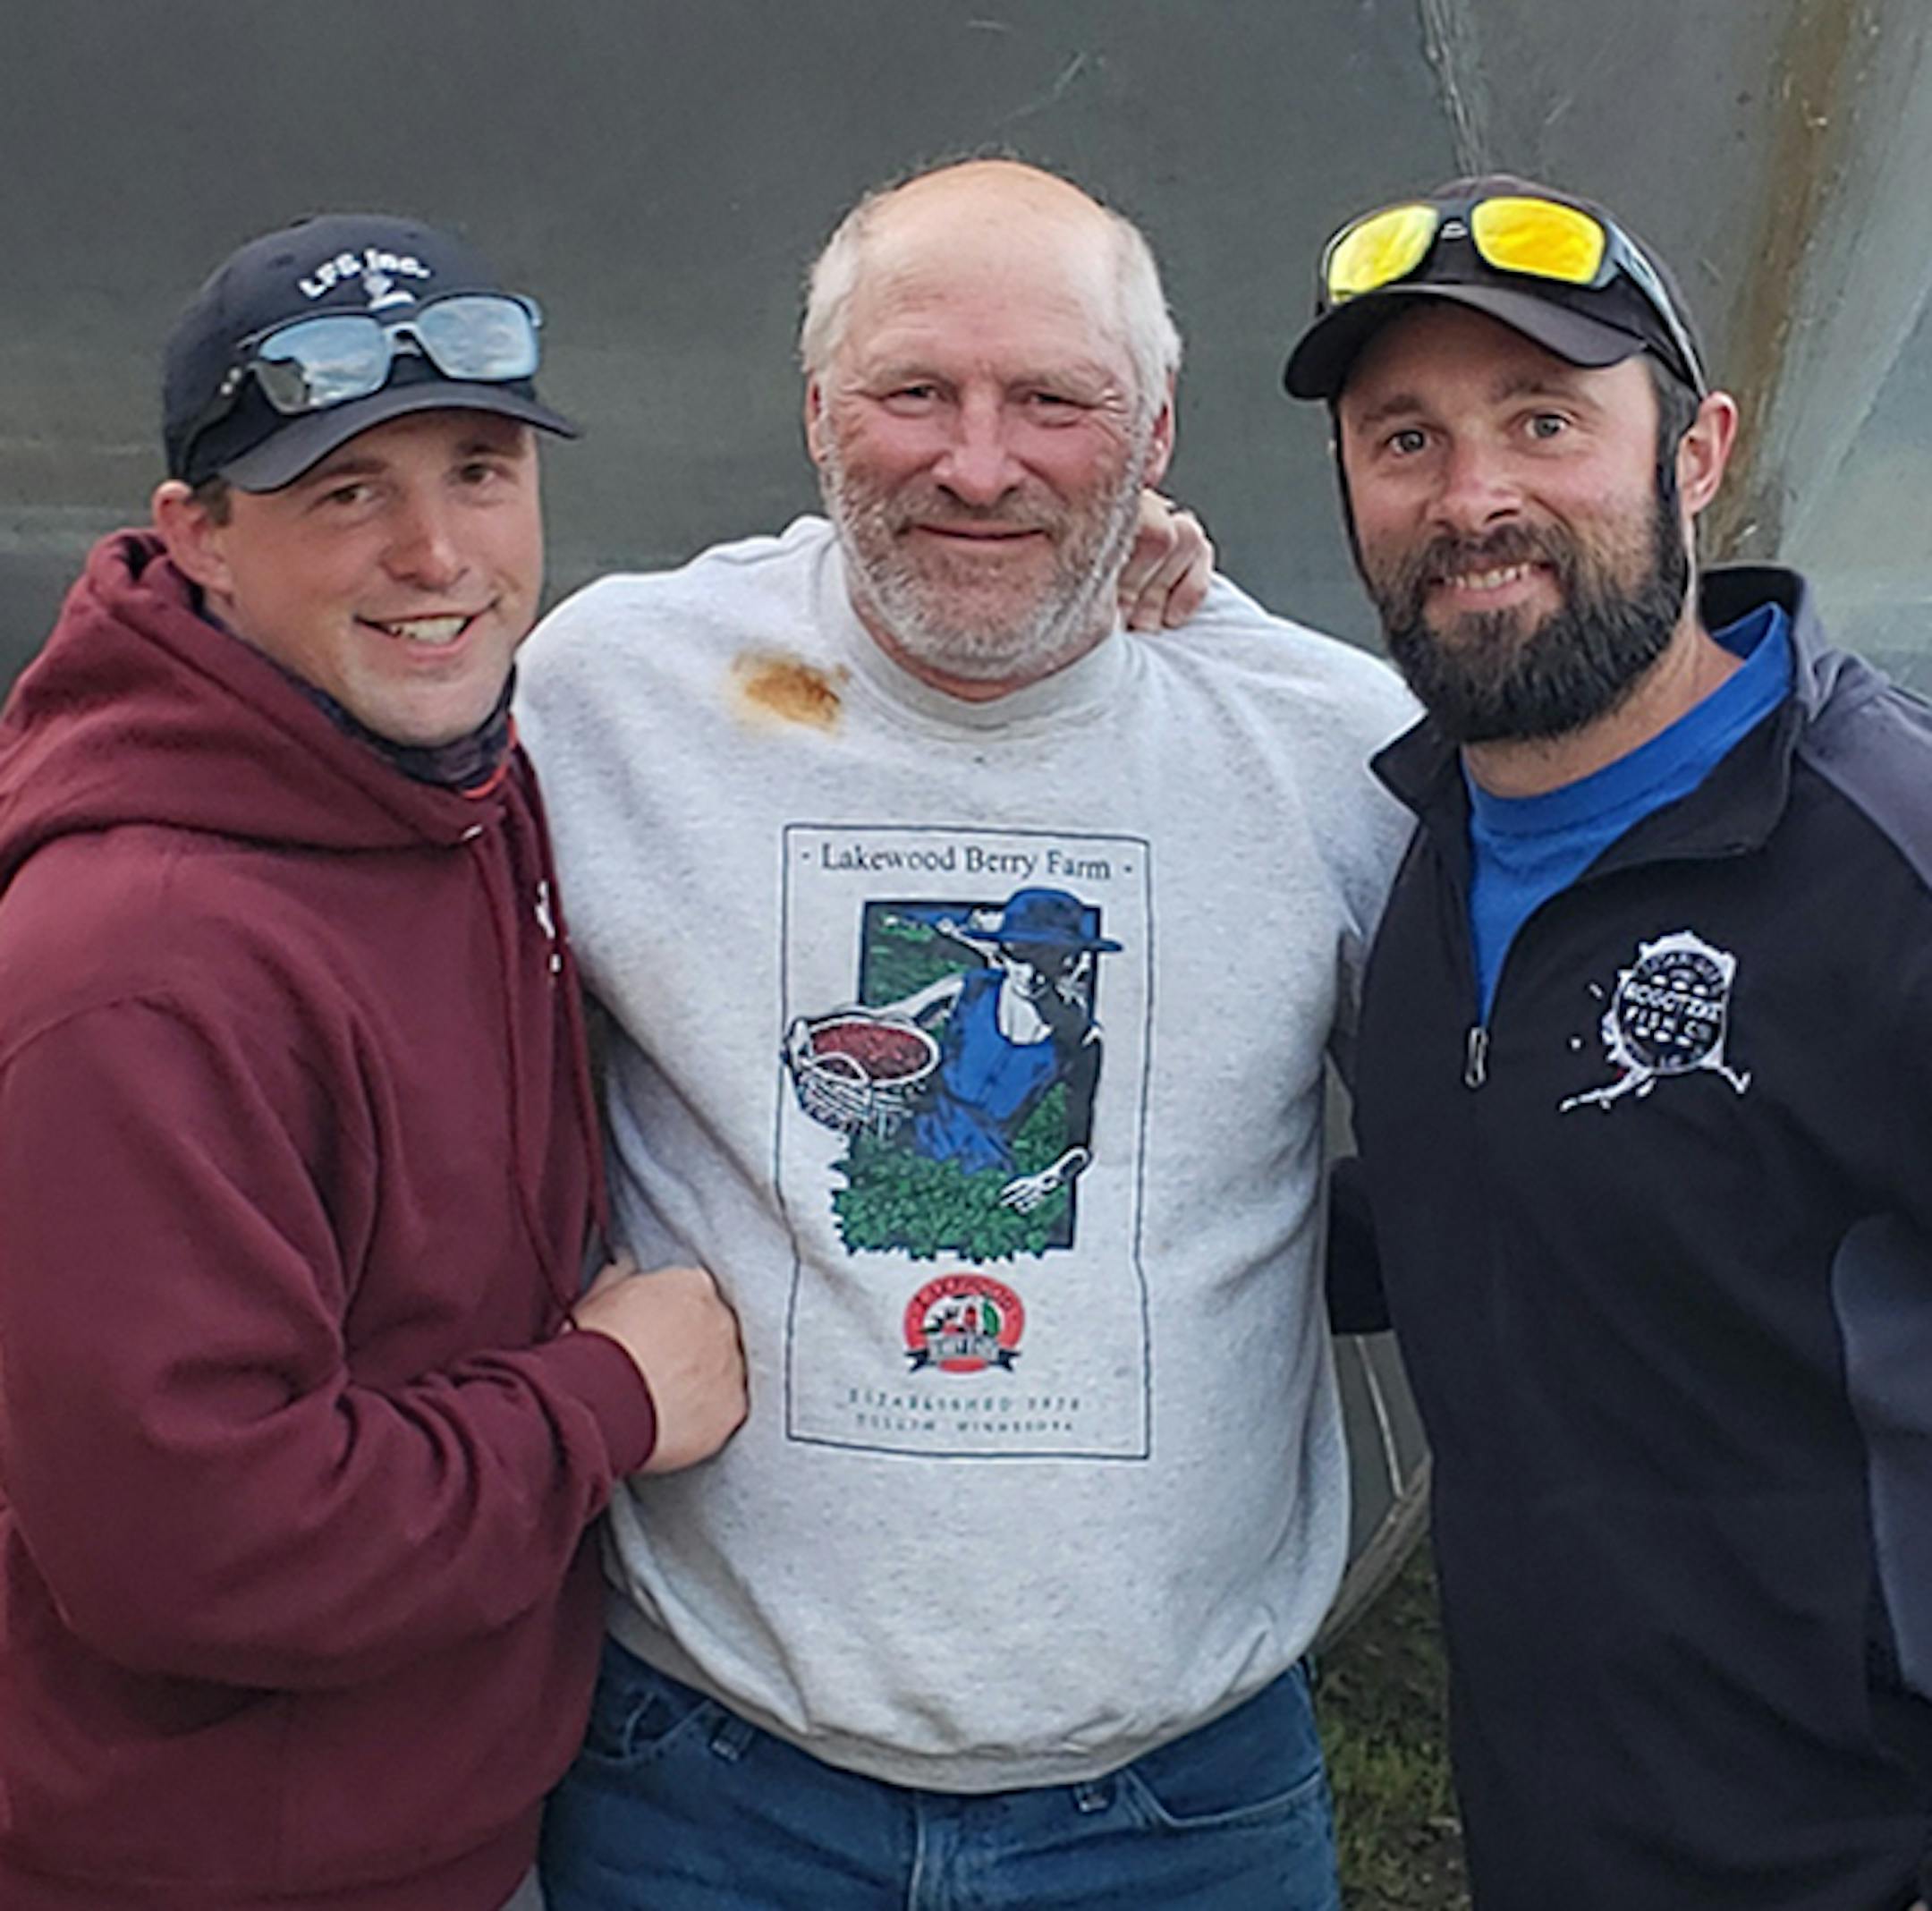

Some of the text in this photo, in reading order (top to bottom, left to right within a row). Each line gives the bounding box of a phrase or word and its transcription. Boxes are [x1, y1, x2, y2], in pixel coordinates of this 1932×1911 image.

[821, 843, 1111, 880] Lakewood Berry Farm
